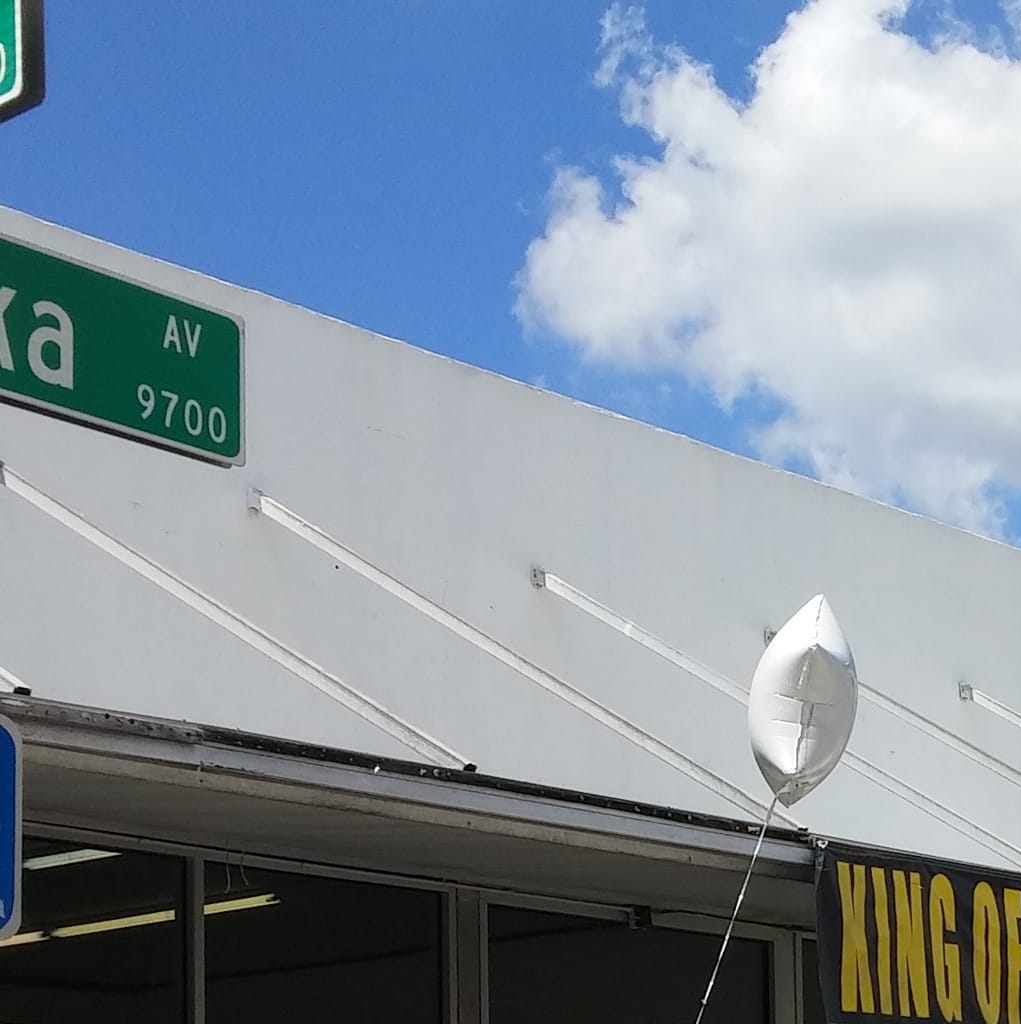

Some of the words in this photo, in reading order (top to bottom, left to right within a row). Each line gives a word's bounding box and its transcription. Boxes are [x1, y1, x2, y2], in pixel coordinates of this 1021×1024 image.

[163, 314, 202, 358] AV
[137, 383, 227, 443] 9700
[836, 861, 963, 1024] KING
